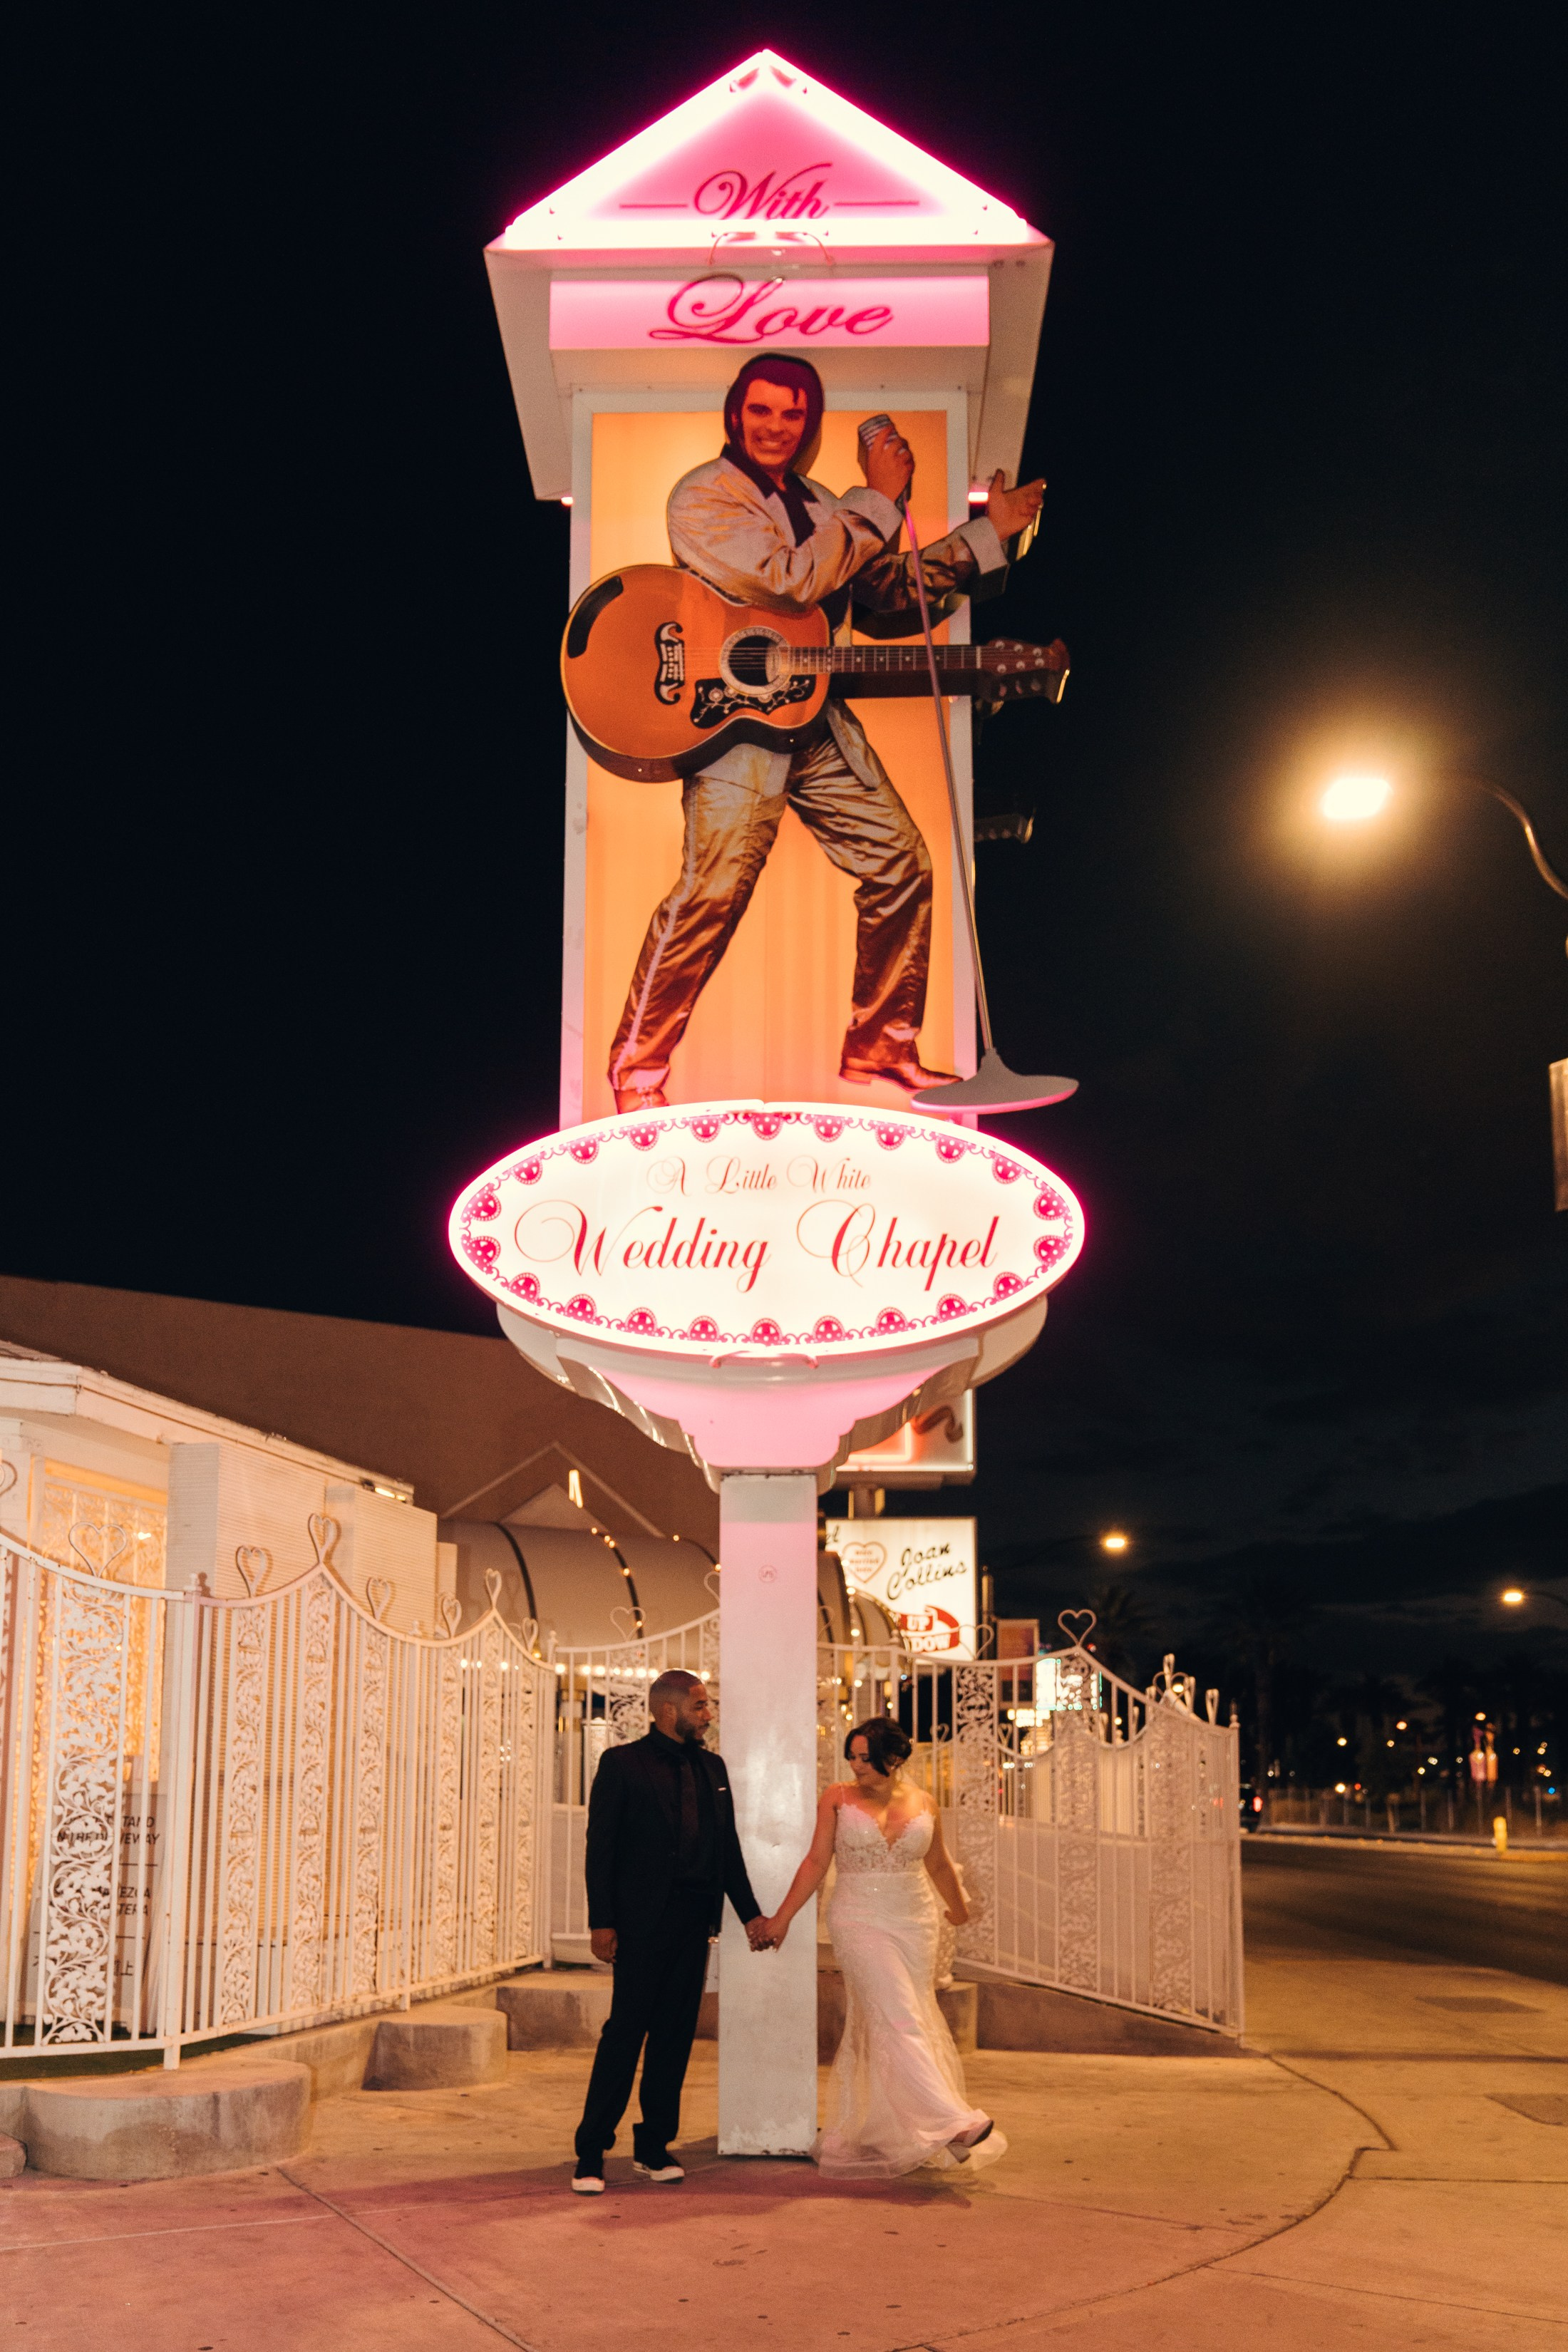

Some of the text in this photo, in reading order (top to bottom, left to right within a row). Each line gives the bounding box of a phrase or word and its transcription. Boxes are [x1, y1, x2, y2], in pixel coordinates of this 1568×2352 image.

[693, 163, 832, 220] With
[649, 273, 894, 344] Love
[646, 1155, 871, 1197] A Little White
[515, 1199, 999, 1293] Wedding Chapel
[902, 1542, 950, 1577] Joan
[887, 1562, 967, 1600] Collins
[907, 1615, 931, 1631] UP
